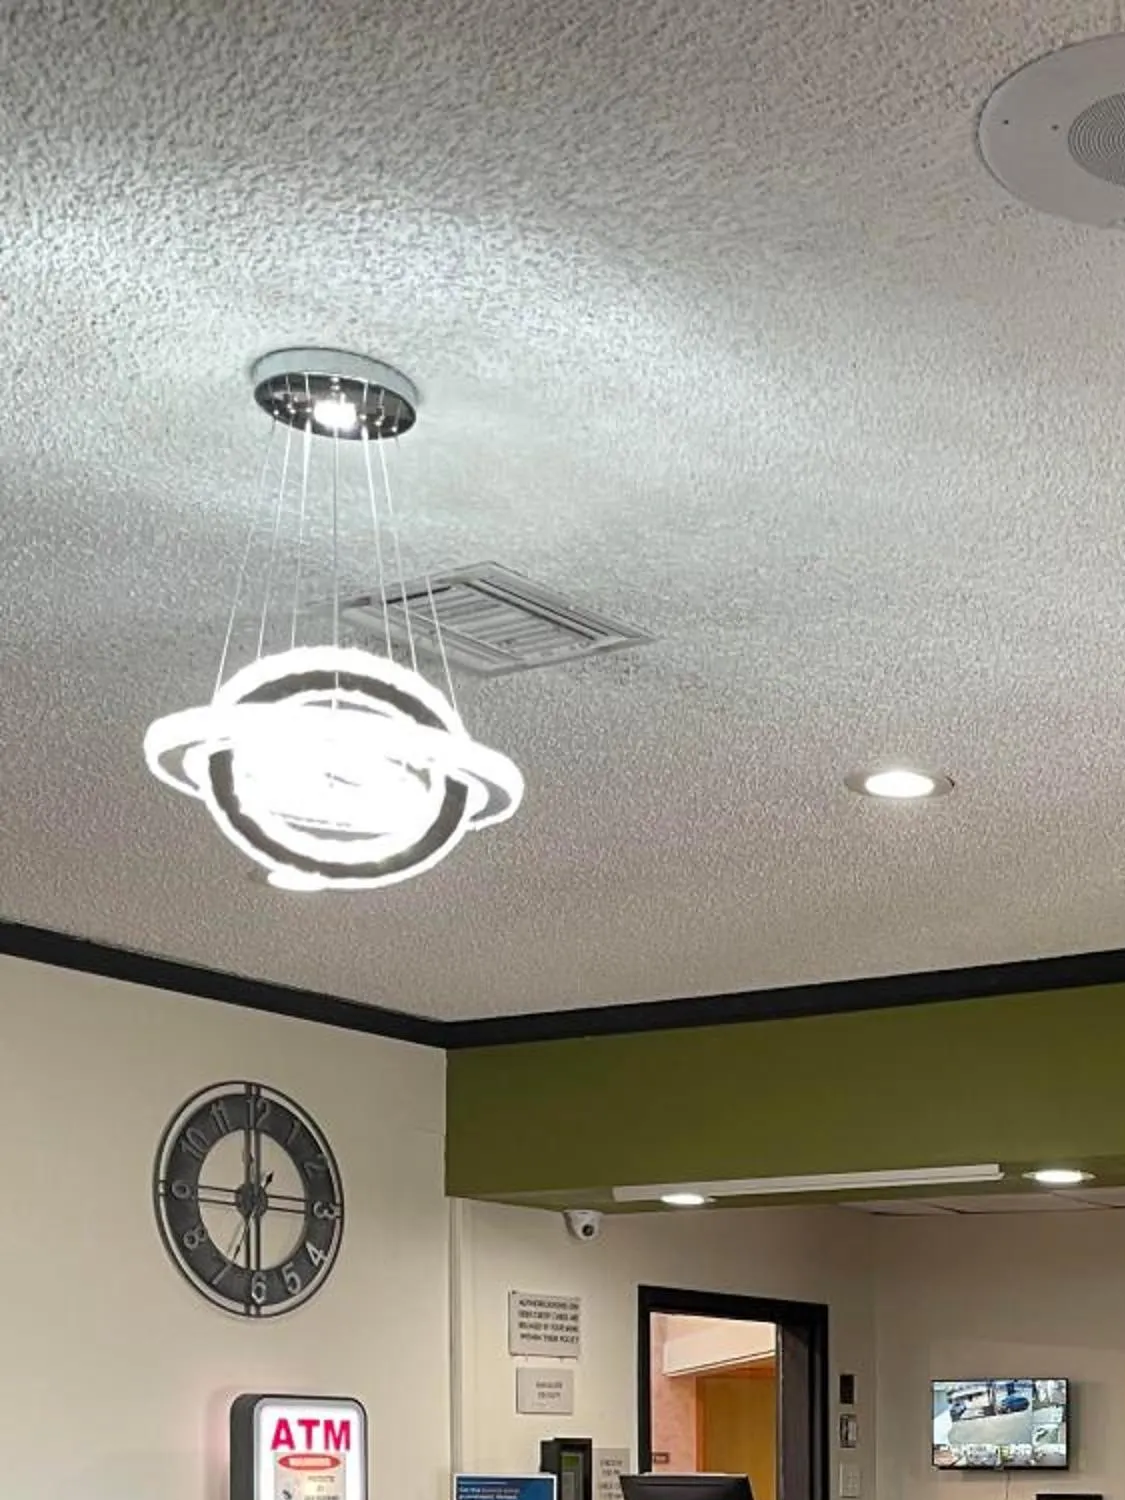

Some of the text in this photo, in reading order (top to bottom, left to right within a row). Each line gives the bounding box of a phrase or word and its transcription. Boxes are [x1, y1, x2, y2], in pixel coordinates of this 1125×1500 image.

[210, 1101, 230, 1134] 11
[248, 1097, 270, 1129] 12
[180, 1127, 209, 1160] 10
[313, 1201, 338, 1220] 3
[183, 1226, 208, 1250] 8
[305, 1240, 328, 1267] 4
[251, 1271, 267, 1304] 6
[281, 1262, 301, 1296] 5
[271, 1417, 351, 1451] ATM
